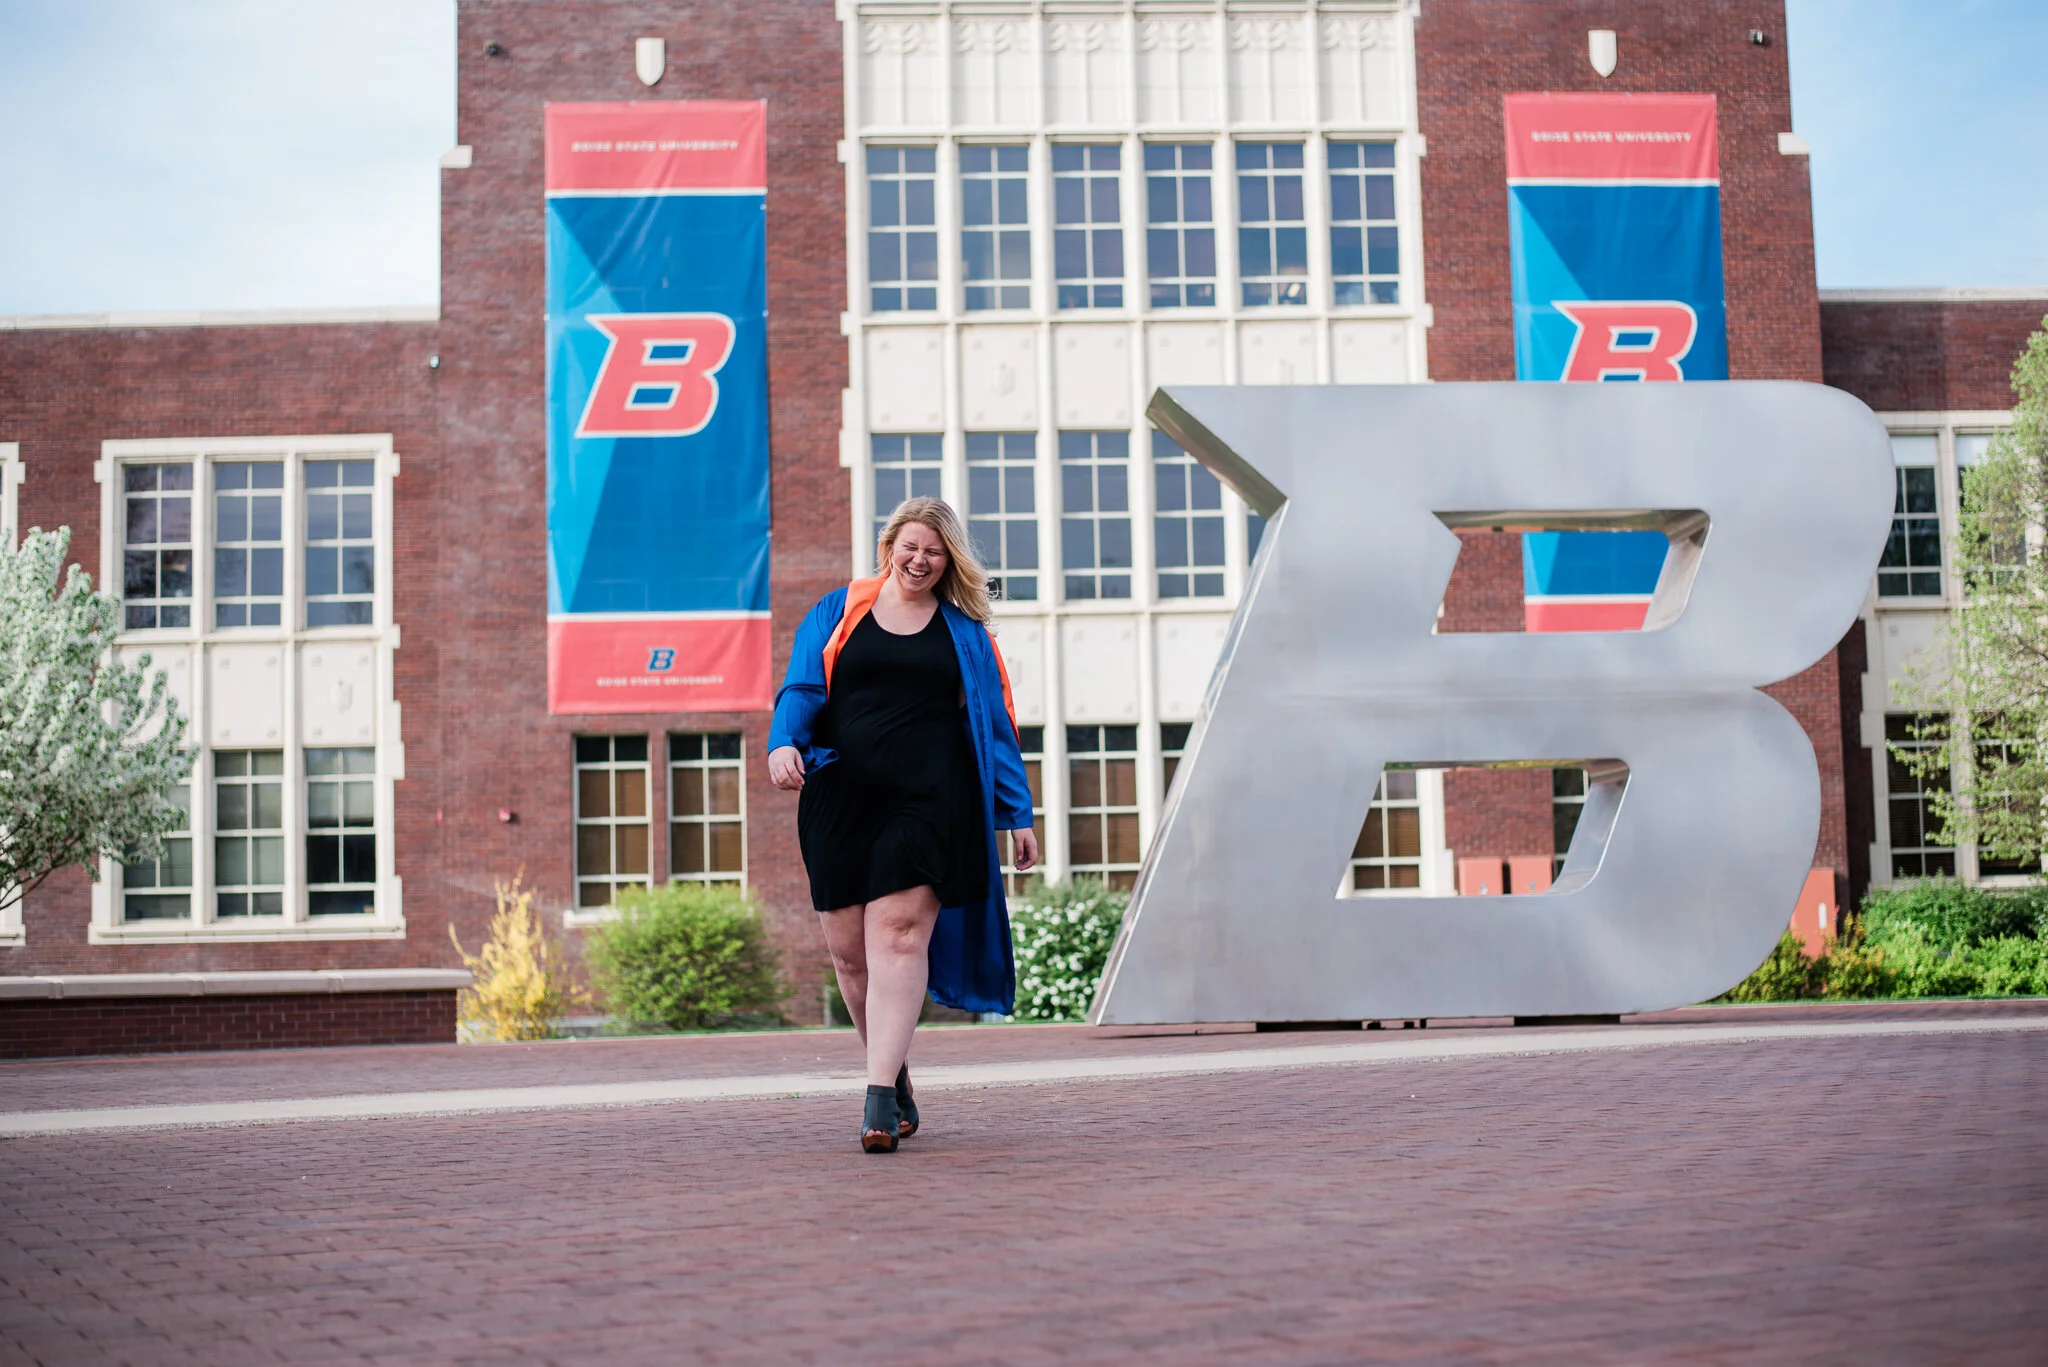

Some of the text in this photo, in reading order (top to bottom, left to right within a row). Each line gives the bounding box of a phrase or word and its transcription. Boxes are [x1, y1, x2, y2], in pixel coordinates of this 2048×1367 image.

[1531, 131, 1691, 143] BOISE STATE UNIVERSITY
[574, 311, 736, 439] B
[646, 647, 676, 672] B
[1088, 380, 1896, 1028] B
